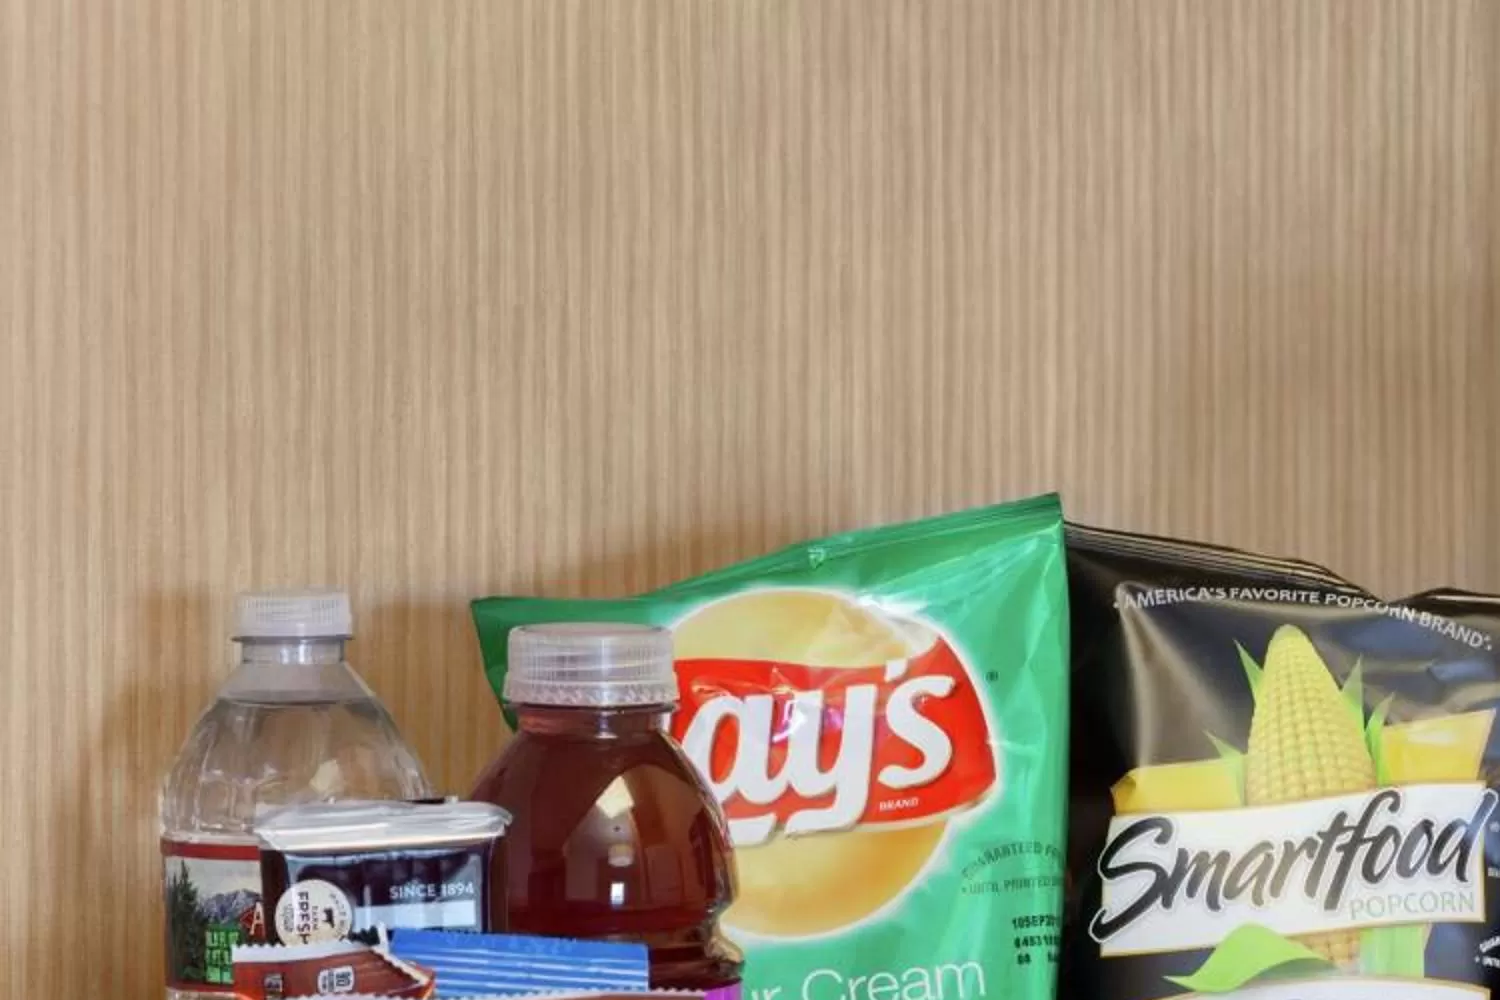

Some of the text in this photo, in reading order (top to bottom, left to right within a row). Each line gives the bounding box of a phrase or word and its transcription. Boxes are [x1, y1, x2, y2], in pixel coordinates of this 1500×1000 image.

[1124, 587, 1226, 609] AMERICA'S
[1230, 587, 1319, 604] FAVORITE
[676, 659, 957, 847] ay's
[878, 796, 919, 813] BRAND
[1090, 787, 1498, 942] Smartfood
[389, 881, 475, 900] SINCE 1894
[1350, 891, 1476, 919] POPCORN
